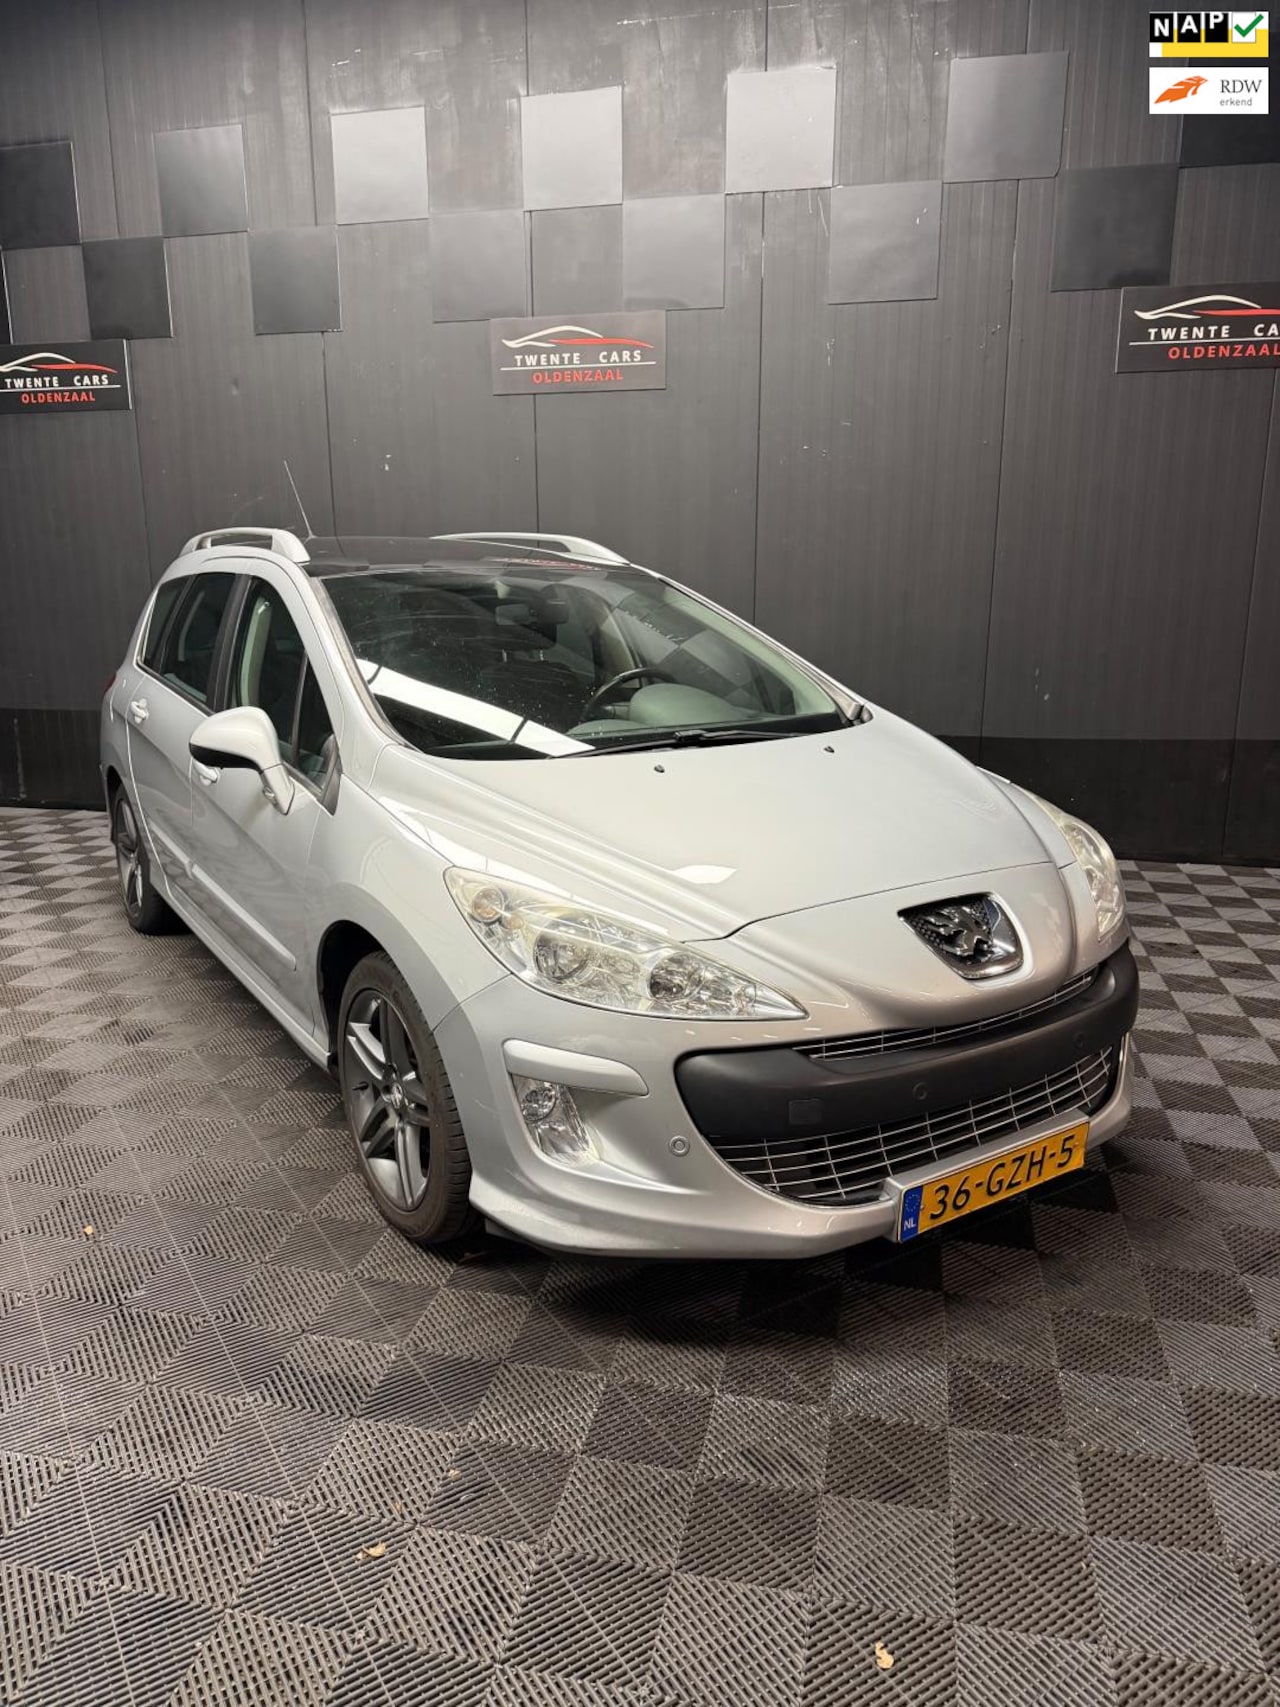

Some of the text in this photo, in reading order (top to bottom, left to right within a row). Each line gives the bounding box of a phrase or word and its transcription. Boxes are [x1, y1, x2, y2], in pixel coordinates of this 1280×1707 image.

[1148, 325, 1230, 341] TWENTE
[514, 350, 642, 367] TWENTE CARS
[1168, 344, 1280, 359] OLDENZAAL
[5, 374, 109, 389] TWENTE CARS
[532, 369, 624, 384] OLDENZAAL
[21, 391, 96, 404] OLDENZAAL
[929, 1134, 1076, 1220] 36-GZH-5
[903, 1217, 917, 1231] NL
